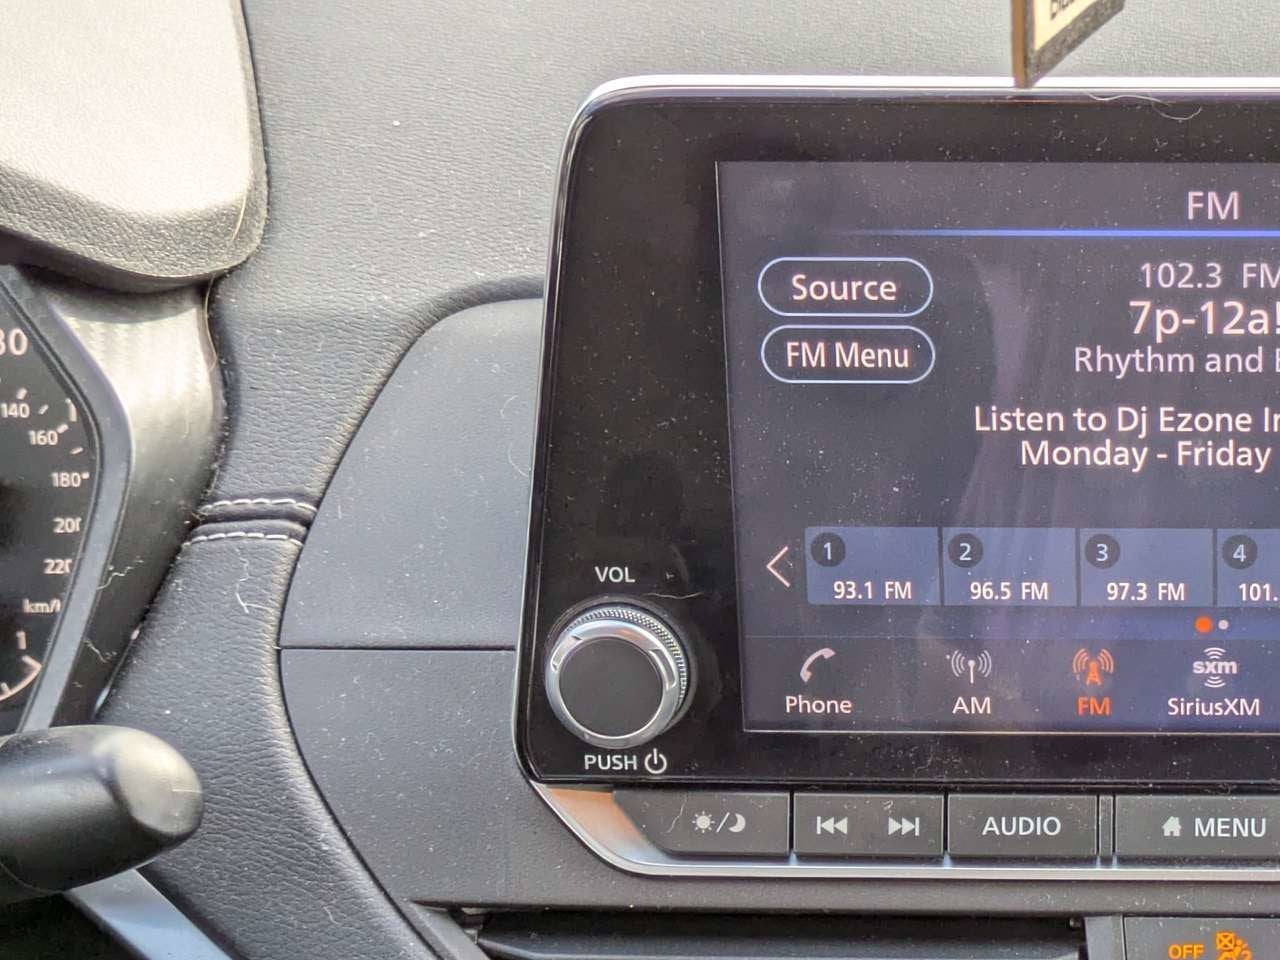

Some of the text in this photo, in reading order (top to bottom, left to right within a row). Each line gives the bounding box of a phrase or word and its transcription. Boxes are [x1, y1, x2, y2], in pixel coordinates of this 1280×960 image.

[1187, 191, 1239, 220] FM
[1140, 262, 1222, 289] 102.3
[791, 273, 897, 301] Source
[786, 341, 909, 368] FM Menu
[1075, 344, 1195, 380] Rhythm
[1204, 345, 1263, 373] and
[0, 402, 30, 419] 140
[975, 405, 1065, 432] Listen
[1072, 407, 1107, 432] to
[1117, 405, 1147, 439] Dj
[1159, 406, 1253, 433] Ezone
[29, 429, 59, 446] 160
[1021, 438, 1149, 473] Monday
[1177, 439, 1272, 474] Friday
[51, 471, 83, 488] 180
[823, 541, 832, 561] 1
[959, 542, 972, 561] 2
[1096, 543, 1109, 562] 3
[1232, 543, 1247, 563] 4
[594, 566, 636, 583] VOL
[833, 580, 912, 600] 93.1 FM
[970, 581, 1049, 601] 96.5 FM
[1106, 582, 1185, 601] 97.3 FM
[1192, 660, 1238, 675] sxm
[785, 694, 853, 714] Phone
[952, 696, 992, 715] AM
[1077, 696, 1111, 715] FM
[1167, 697, 1260, 716] SiriusXM
[584, 754, 638, 771] PUSH
[981, 816, 1062, 836] AUDIO
[1194, 817, 1267, 838] MENU
[1168, 943, 1204, 960] OFF
